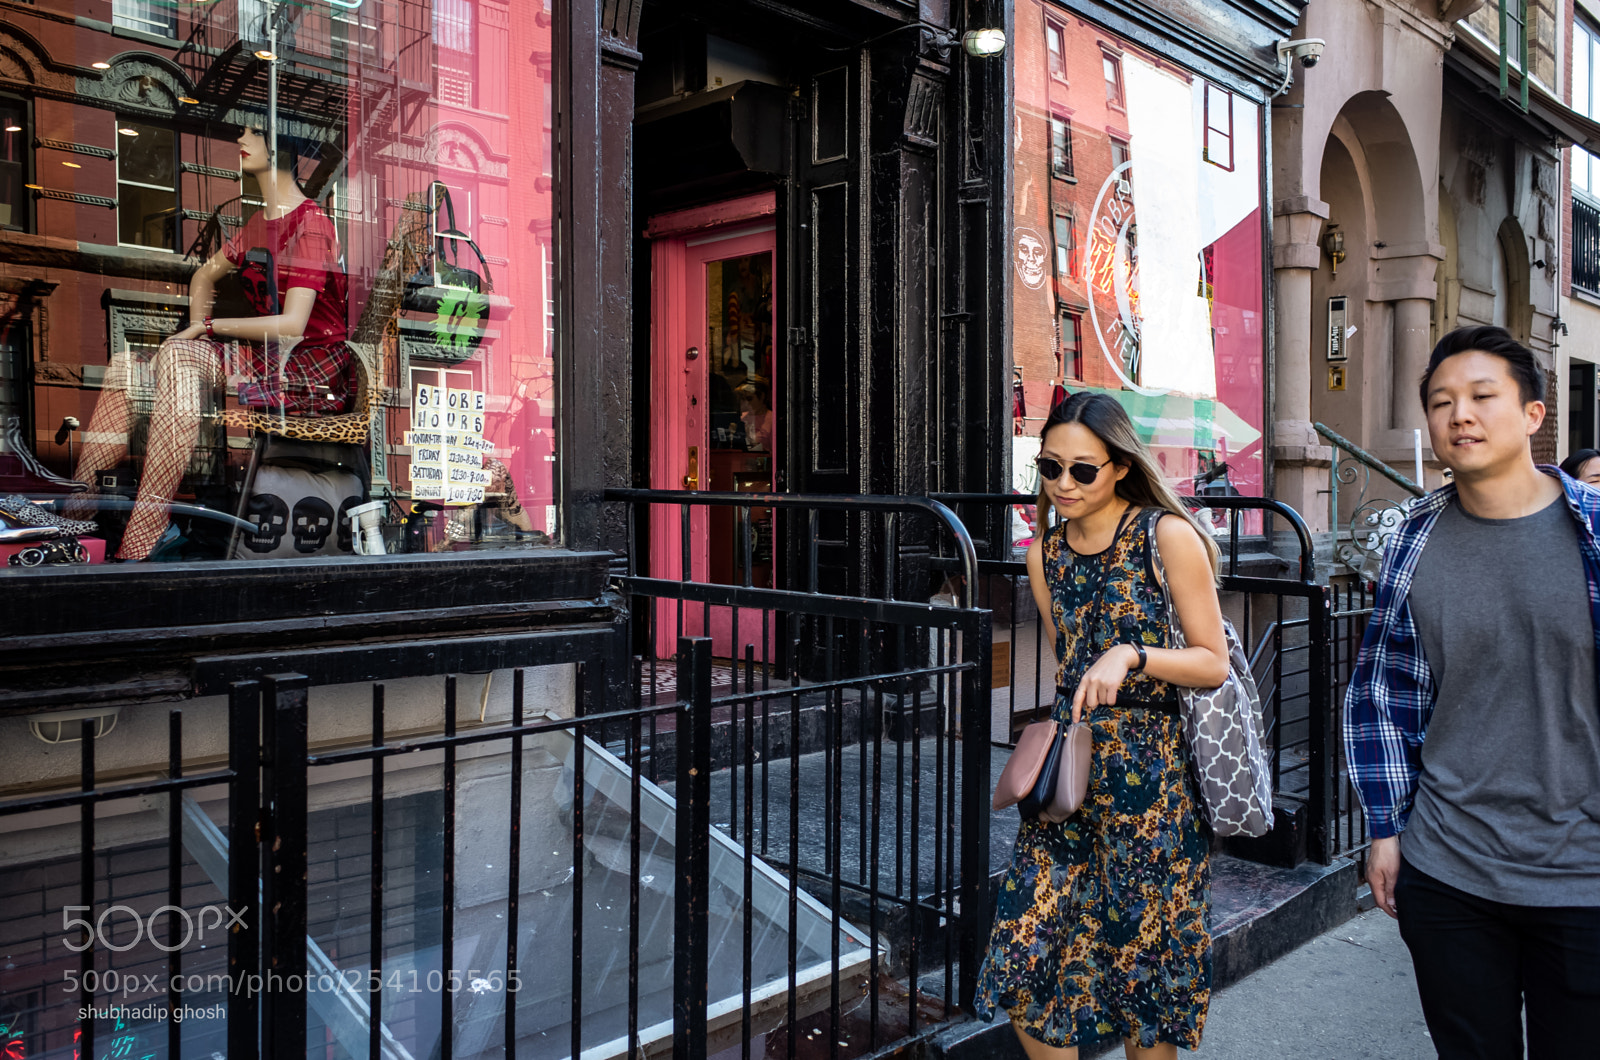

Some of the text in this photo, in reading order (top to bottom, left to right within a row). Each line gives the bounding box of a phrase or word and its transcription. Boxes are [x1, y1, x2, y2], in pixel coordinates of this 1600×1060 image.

[1101, 181, 1135, 238] OBE
[1106, 317, 1140, 374] FIEN
[419, 388, 483, 410] STORE
[417, 410, 482, 433] HOURS
[418, 448, 441, 461] FRIDAY
[412, 465, 443, 480] SATURDAY
